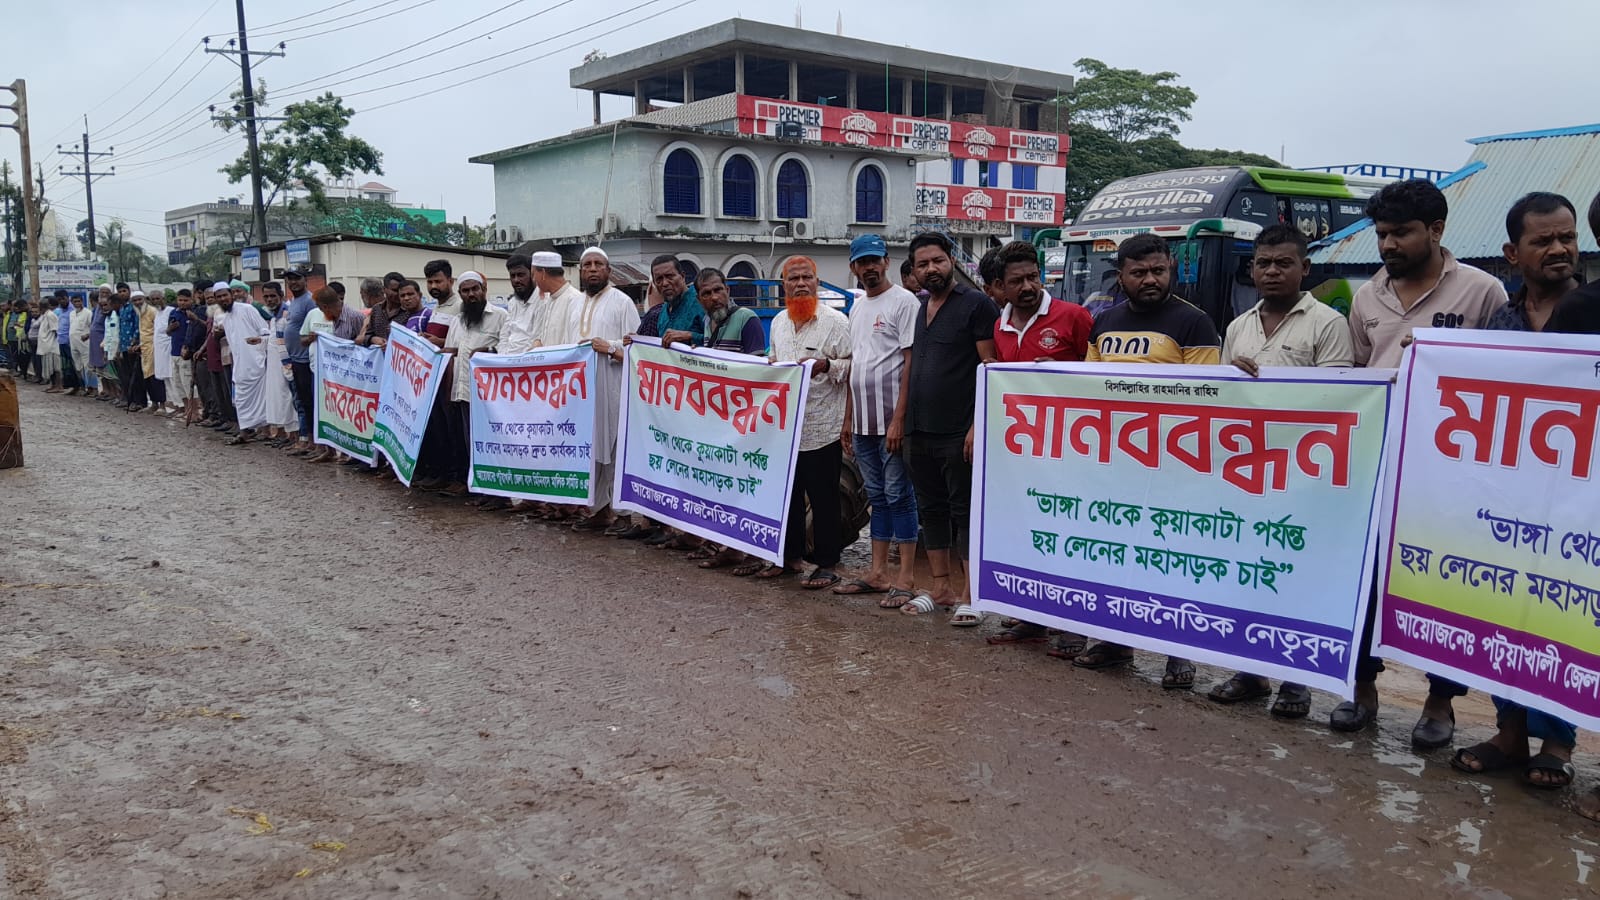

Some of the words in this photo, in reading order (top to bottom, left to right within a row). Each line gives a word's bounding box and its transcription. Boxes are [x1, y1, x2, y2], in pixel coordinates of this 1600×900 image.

[779, 105, 821, 127] PREMIER
[914, 123, 949, 141] PREMIER
[1027, 135, 1058, 151] PREMIER
[916, 188, 946, 205] REMIER
[1023, 195, 1054, 211] PREMIER
[1081, 207, 1204, 222] Deluxe
[1086, 189, 1215, 213] Bismillah
[473, 361, 587, 409] মানববন্ধন
[637, 359, 791, 436] মানববন্ধন
[1104, 379, 1150, 394] বিসমিল্লাহির
[1152, 382, 1192, 396] রাহমানির
[1193, 383, 1220, 397] রাহিম
[1002, 392, 1361, 497] মানববন্ধন
[1434, 375, 1600, 482] মান
[649, 452, 662, 472] ছয়
[666, 458, 690, 479] লেনের
[692, 467, 734, 493] মহাসড়ক
[671, 435, 694, 454] থেকে
[696, 443, 738, 466] কুয়াকাটা
[742, 448, 769, 472] পর্যন্ত
[682, 496, 739, 528] রাজনৈতিক
[739, 517, 780, 546] নেতৃবৃন্দ
[1088, 497, 1142, 528] থেকে
[1150, 505, 1246, 541] কুয়াকাটা
[1253, 513, 1307, 553] পর্যন্ত
[1030, 528, 1059, 557] ছয়
[1064, 534, 1129, 568] লেনের
[1134, 545, 1230, 586] মহাসড়ক
[1398, 541, 1433, 577] ছয়
[1439, 553, 1519, 597] লেনের
[1104, 591, 1237, 639] রাজনৈতিক
[1244, 621, 1349, 669] নেতৃবৃন্দ
[1481, 629, 1562, 684] পটুয়াখালী
[1563, 661, 1600, 700] জেল
